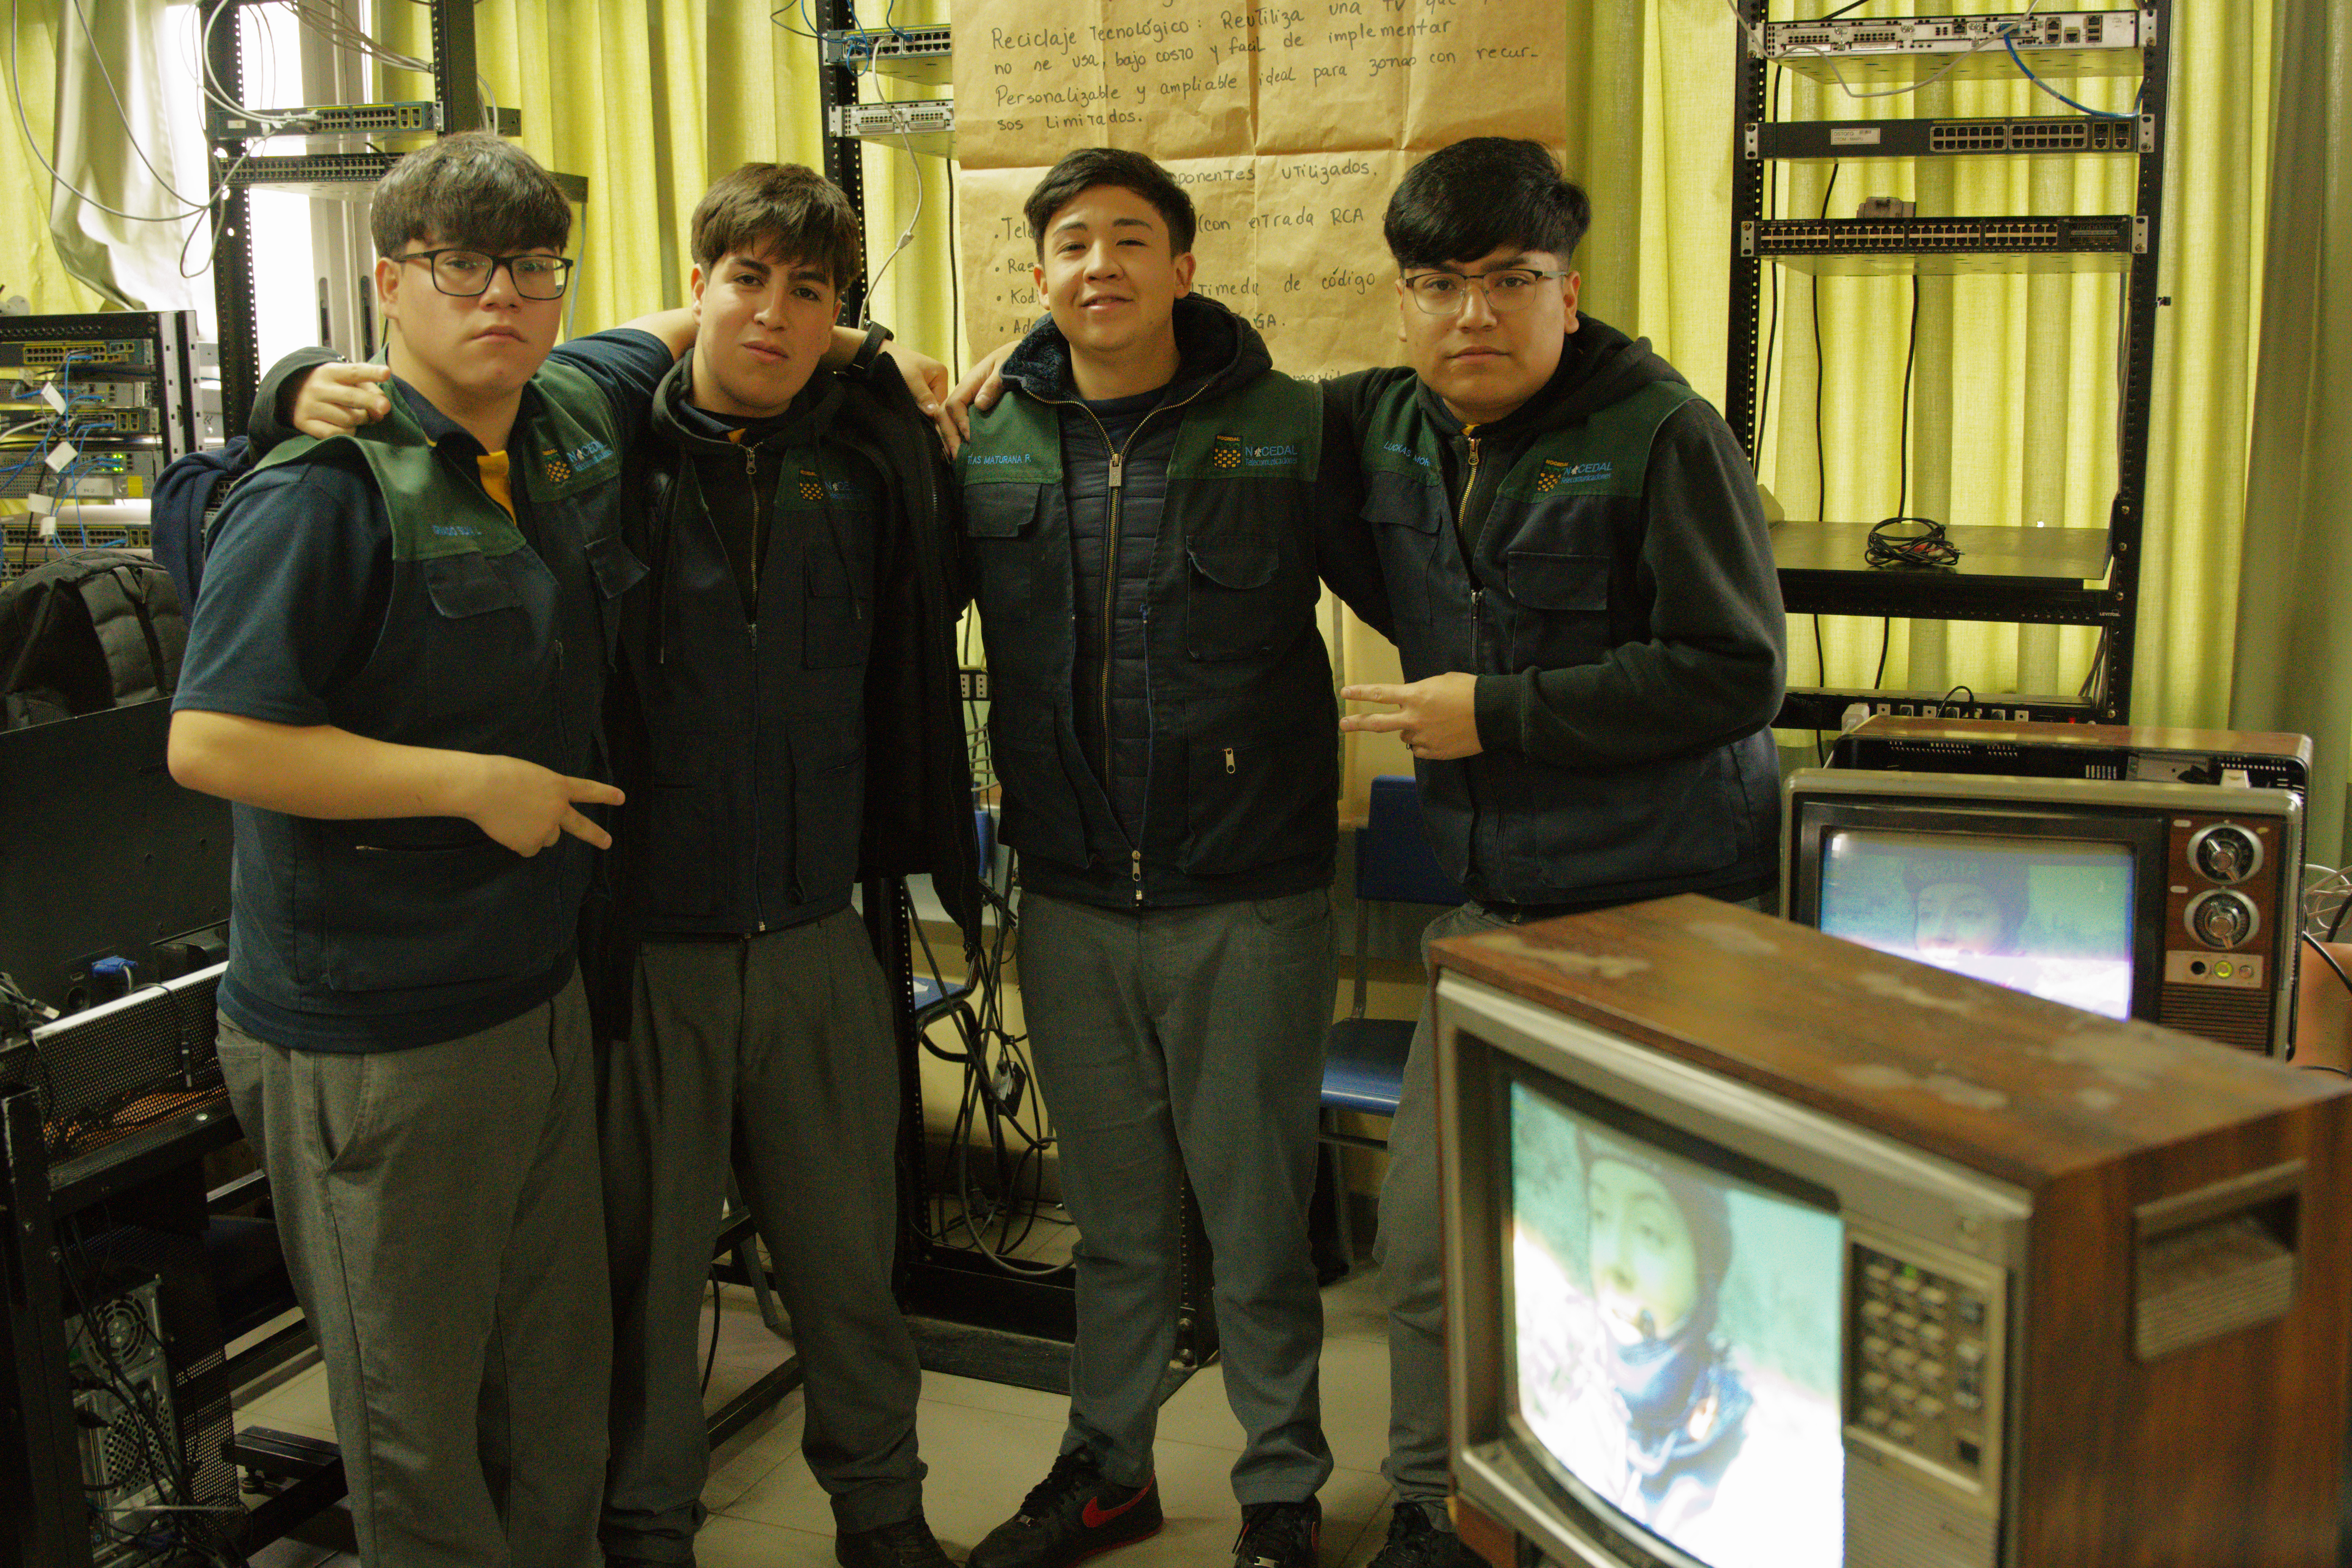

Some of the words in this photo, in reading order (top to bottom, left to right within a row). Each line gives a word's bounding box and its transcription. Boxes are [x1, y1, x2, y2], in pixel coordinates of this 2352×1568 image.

[991, 27, 1076, 55] Reciclaje
[1329, 2, 1362, 15] una
[995, 63, 1012, 74] no
[1034, 59, 1052, 71] se
[1116, 50, 1146, 73] bajo
[1209, 45, 1220, 65] y
[1229, 36, 1266, 54] facil
[1283, 32, 1304, 47] de
[1329, 19, 1451, 51] implementar
[996, 85, 1121, 107] Personalizable
[1136, 86, 1146, 104] y
[1160, 73, 1237, 100] ampliable
[1259, 67, 1296, 86] ideal
[1314, 65, 1347, 87] para
[1429, 52, 1456, 63] con
[997, 120, 1024, 131] sos
[1331, 208, 1363, 226] RCA
[1284, 273, 1301, 292] de
[1322, 266, 1375, 295] código
[984, 455, 1022, 465] MATURANA
[1383, 441, 1412, 457] LUCKAS
